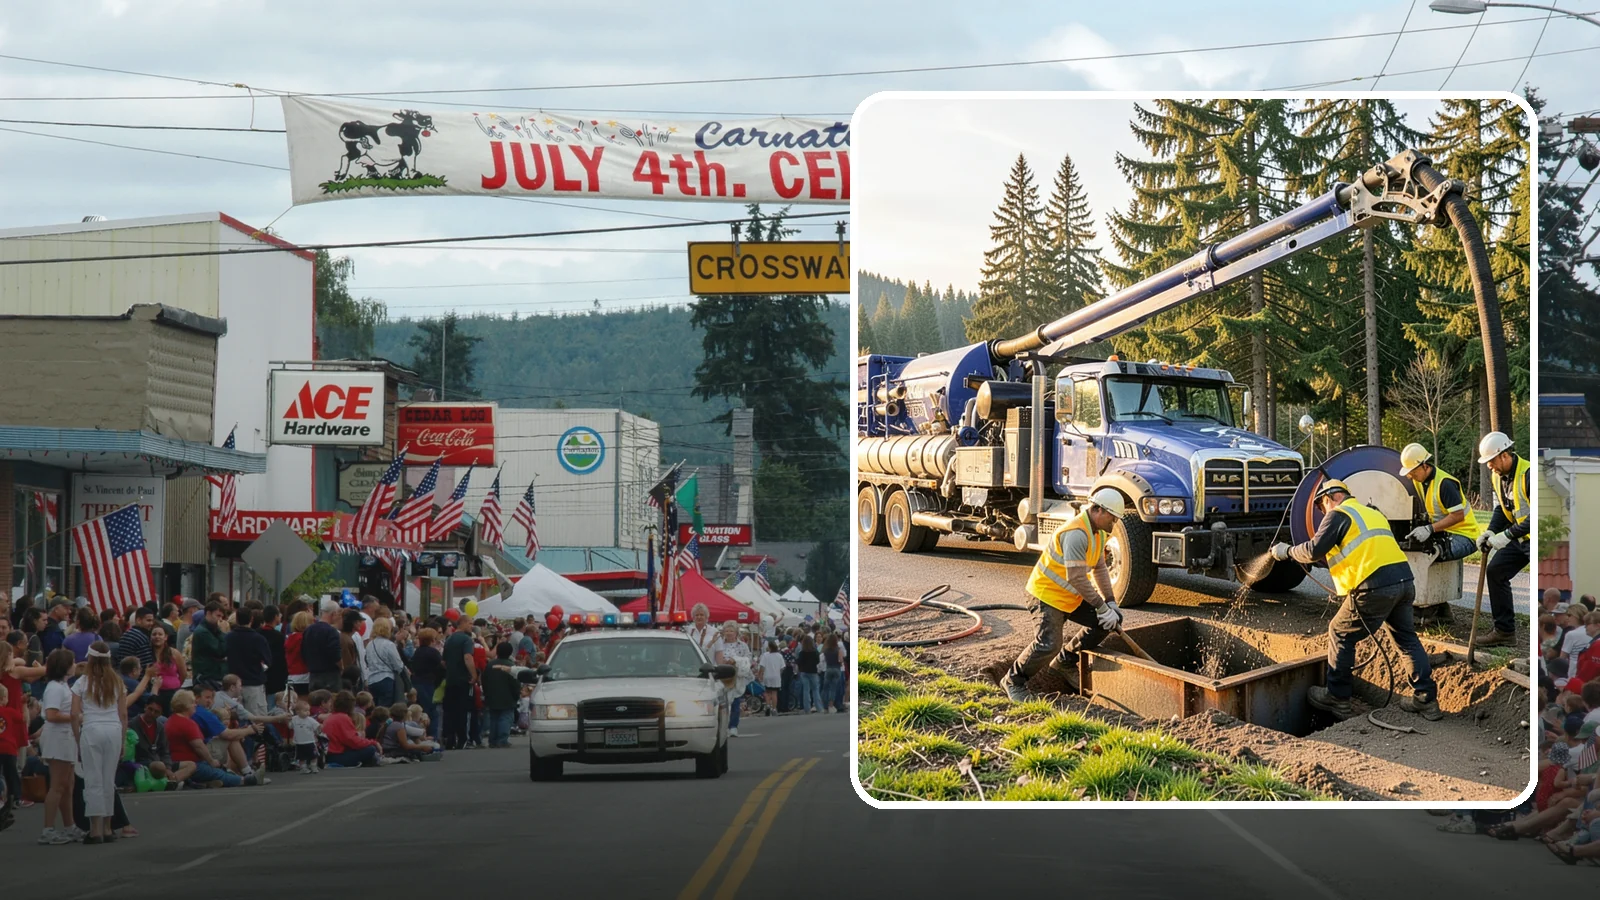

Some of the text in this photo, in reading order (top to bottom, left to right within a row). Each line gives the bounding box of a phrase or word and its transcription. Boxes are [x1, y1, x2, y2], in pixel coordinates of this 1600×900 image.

[694, 121, 850, 150] Carnat
[481, 140, 605, 192] JULY
[632, 150, 746, 197] 4th.
[697, 254, 850, 280] CROSSWA
[283, 380, 374, 420] ACE
[405, 409, 486, 422] CEDAR LOG
[283, 421, 371, 437] Hardware
[416, 428, 477, 447] Coca-Cola
[96, 485, 124, 495] Vincent
[126, 486, 136, 495] de
[138, 486, 155, 496] Paul
[81, 503, 154, 522] THT
[688, 526, 741, 535] CRNATION
[699, 535, 730, 543] GLASS
